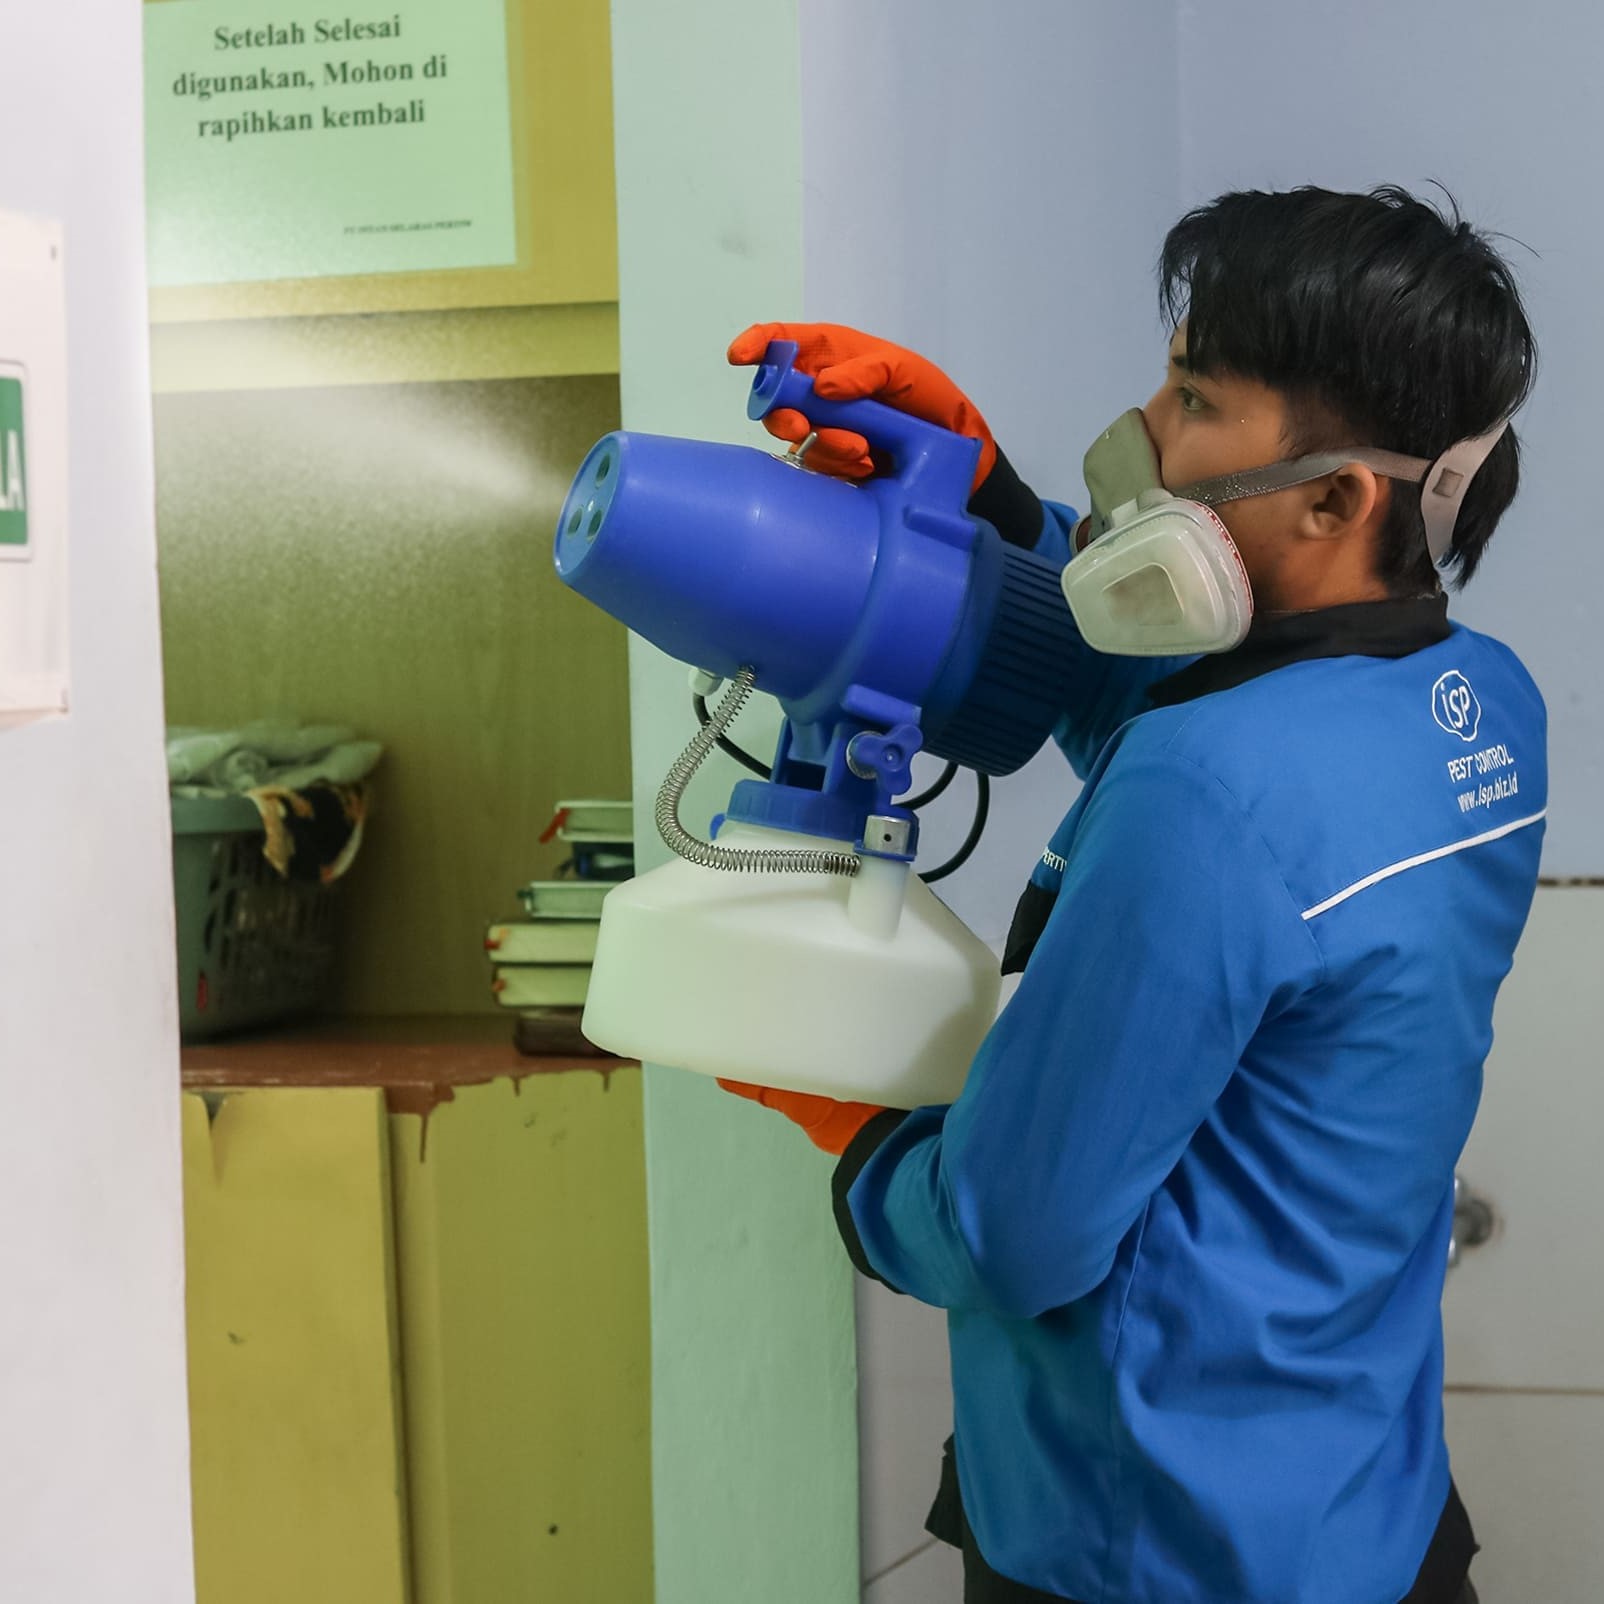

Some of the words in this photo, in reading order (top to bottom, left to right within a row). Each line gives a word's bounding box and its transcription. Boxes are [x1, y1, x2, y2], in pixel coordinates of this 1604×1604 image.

[213, 21, 306, 51] Setelah
[313, 13, 401, 45] Selesai
[171, 68, 316, 101] digunakan,
[322, 59, 415, 86] Mohon
[422, 53, 448, 80] di
[197, 109, 314, 143] rapihkan
[321, 98, 426, 130] kembali
[1447, 754, 1474, 784] PEST
[1473, 743, 1514, 775] CONTROL
